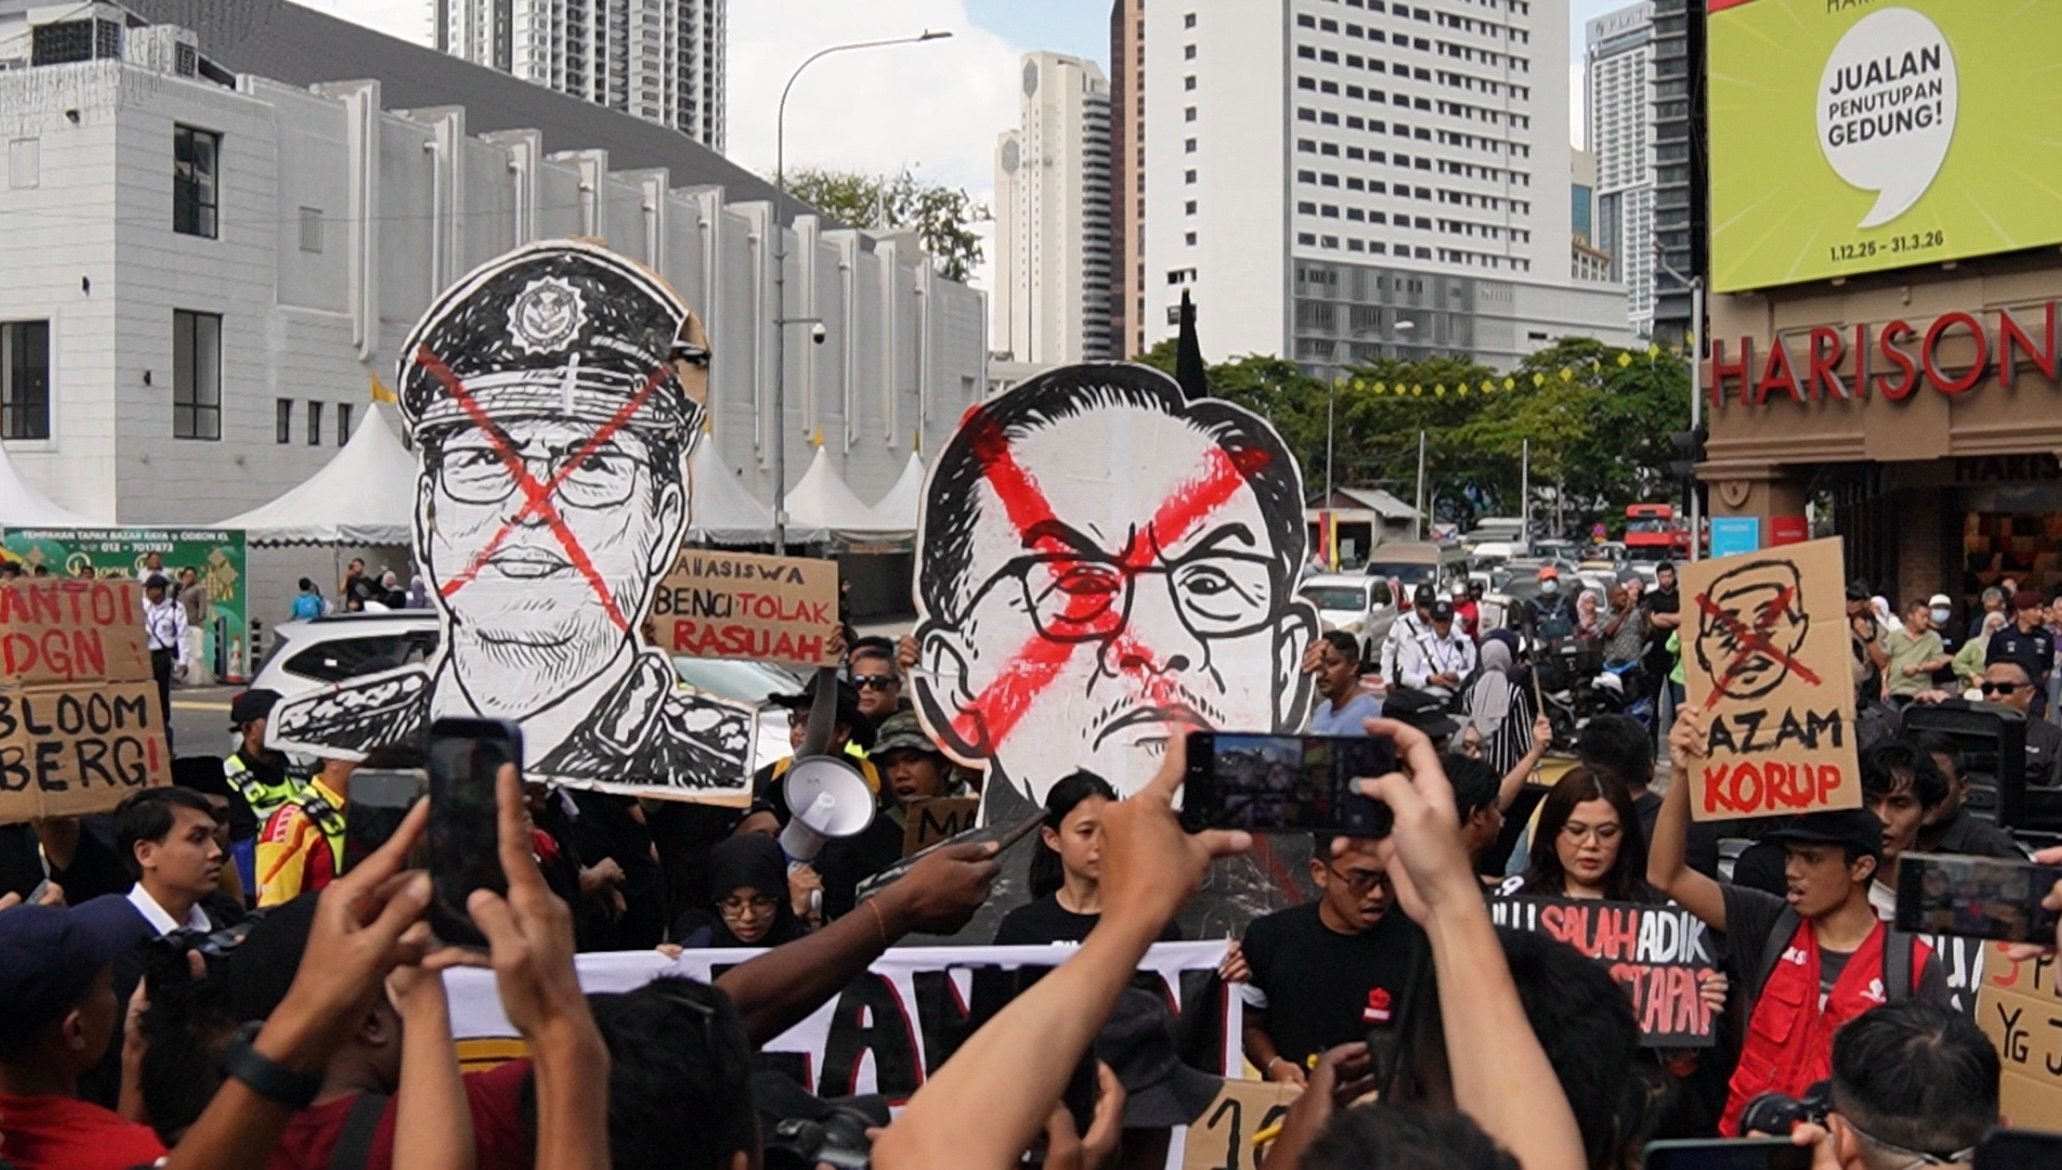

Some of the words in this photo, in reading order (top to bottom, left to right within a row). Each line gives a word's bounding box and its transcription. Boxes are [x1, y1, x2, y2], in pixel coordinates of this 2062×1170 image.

[1829, 43, 1940, 95] JUALAN
[1828, 100, 1942, 147] GEDUNG!
[1829, 78, 1942, 120] PENUTUPAN
[1830, 240, 1876, 261] 1.12.25
[1891, 230, 1944, 252] 31.3.26
[1711, 302, 2056, 408] HARISON
[668, 556, 804, 584] AHASISWA
[654, 585, 732, 618] BENCI
[736, 593, 831, 624] TOLAK
[3, 628, 106, 682] DGN
[673, 619, 824, 663] RASUAH
[1707, 706, 1842, 760] AZAM
[0, 736, 160, 792] BERG!
[1704, 761, 1841, 813] KORUP
[1636, 911, 1711, 963] ADIK
[1997, 1002, 2030, 1063] YG
